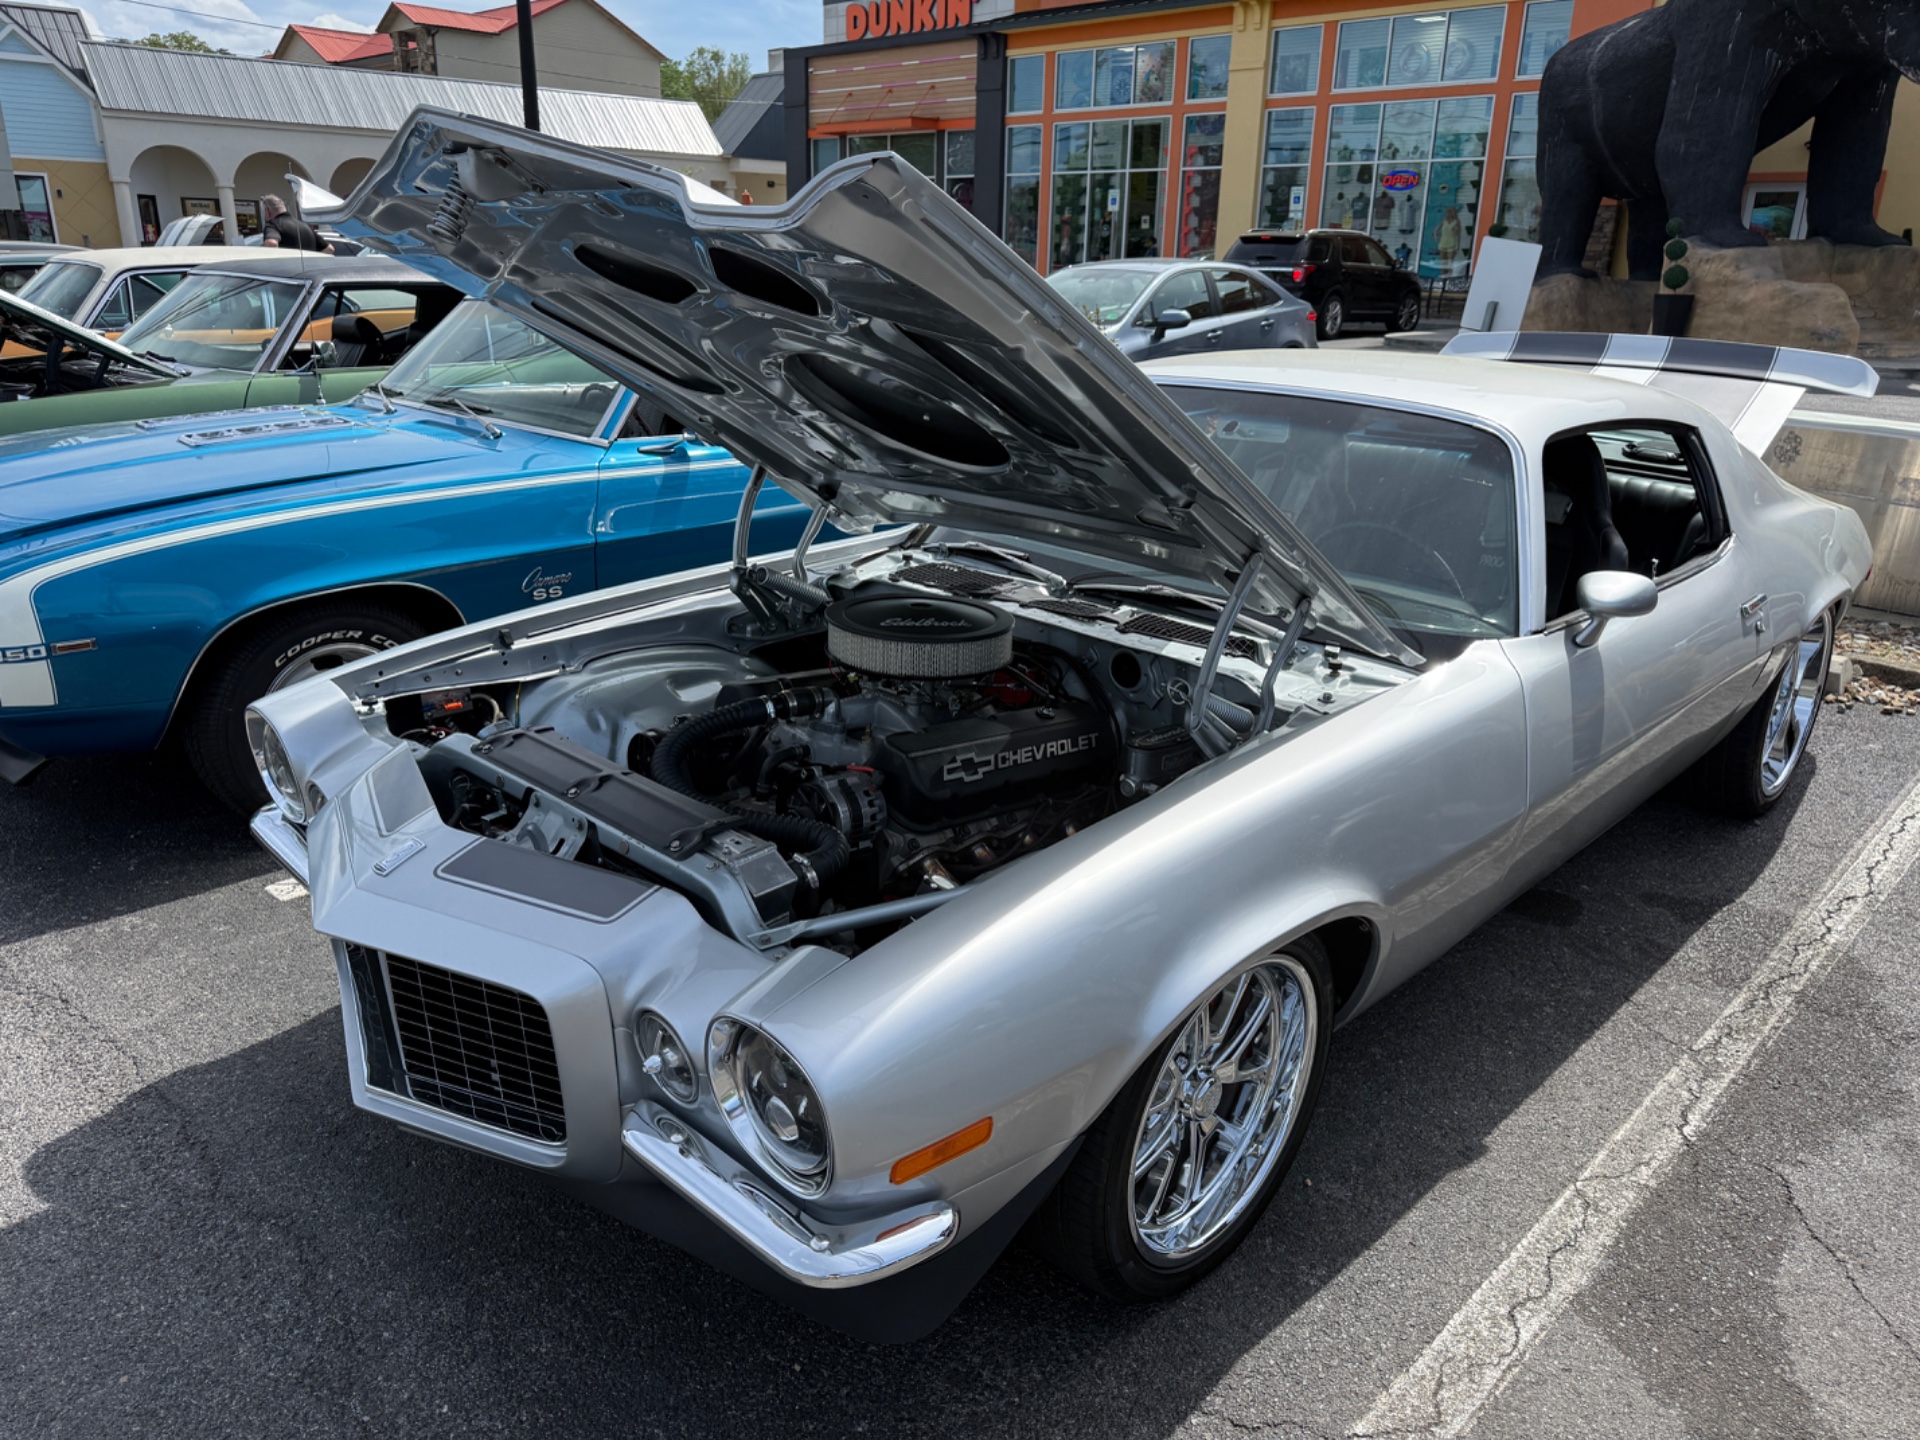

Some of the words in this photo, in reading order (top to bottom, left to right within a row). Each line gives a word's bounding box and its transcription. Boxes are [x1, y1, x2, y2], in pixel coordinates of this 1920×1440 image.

[1382, 175, 1419, 187] OPEN
[521, 566, 572, 593] Camaro
[533, 585, 563, 600] SS
[880, 617, 972, 627] Edelbrock
[0, 645, 47, 661] 50
[274, 629, 363, 668] COOPER
[997, 733, 1098, 768] CHEVROLET
